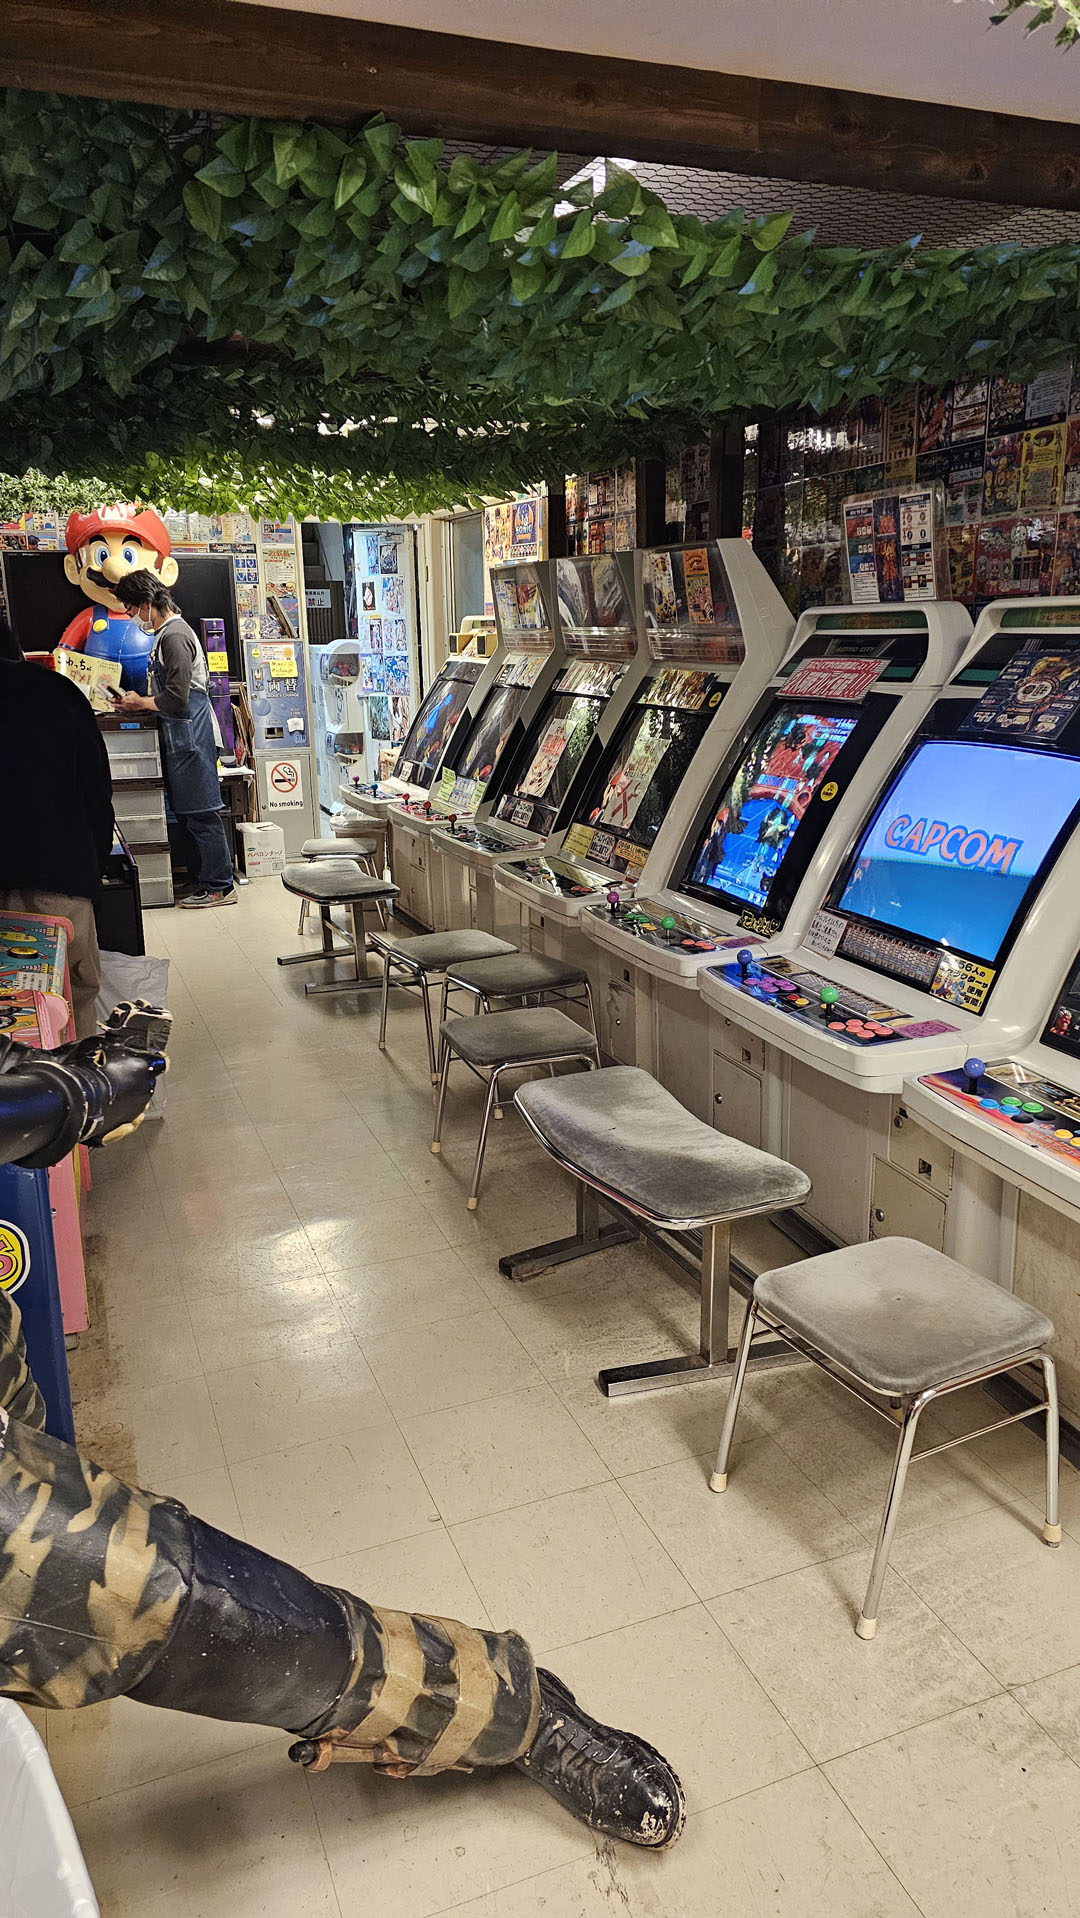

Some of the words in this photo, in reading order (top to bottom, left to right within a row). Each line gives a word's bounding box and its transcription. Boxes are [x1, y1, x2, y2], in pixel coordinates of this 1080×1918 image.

[516, 524, 532, 534] SONIC
[267, 678, 298, 692] 両替
[278, 800, 304, 808] smoking
[884, 814, 1024, 873] CAPCOM
[958, 960, 986, 978] 56人の
[940, 966, 988, 988] ャラクターが
[966, 986, 984, 998] 使用
